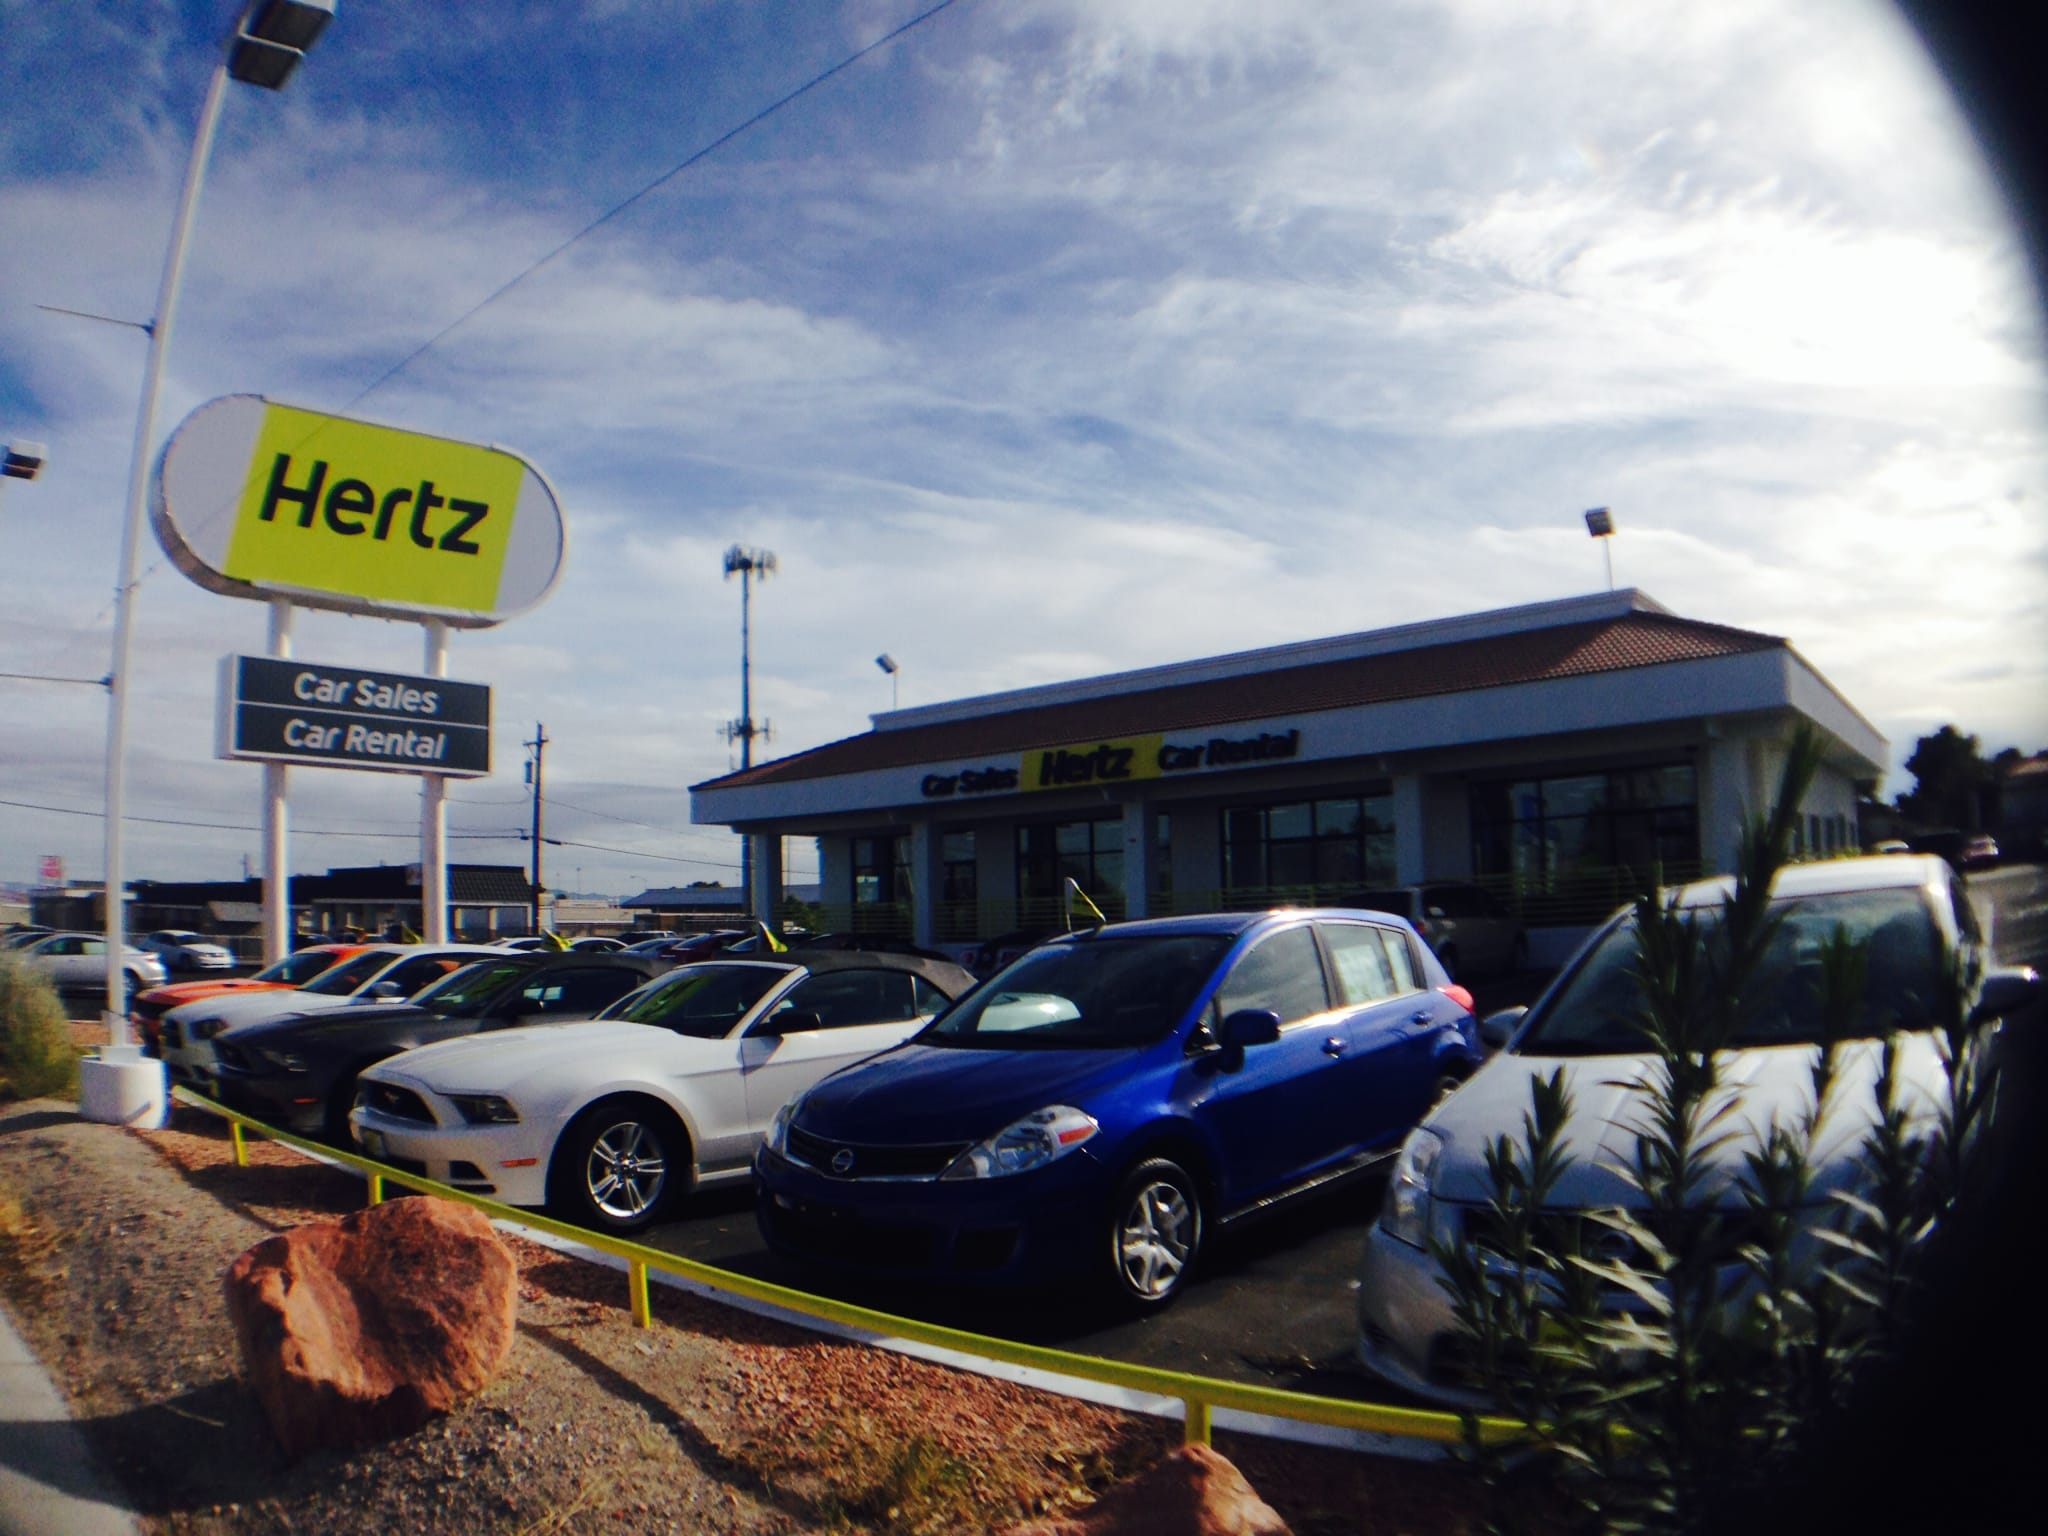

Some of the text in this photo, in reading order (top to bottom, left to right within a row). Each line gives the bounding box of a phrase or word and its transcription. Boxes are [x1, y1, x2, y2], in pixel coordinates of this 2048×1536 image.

[257, 452, 490, 556] Hertz
[293, 671, 440, 714] Car Sales
[283, 718, 447, 760] Car Rental
[1157, 728, 1300, 771] Car Rental
[921, 766, 1019, 797] Car Sales
[1039, 745, 1135, 786] Hertz
